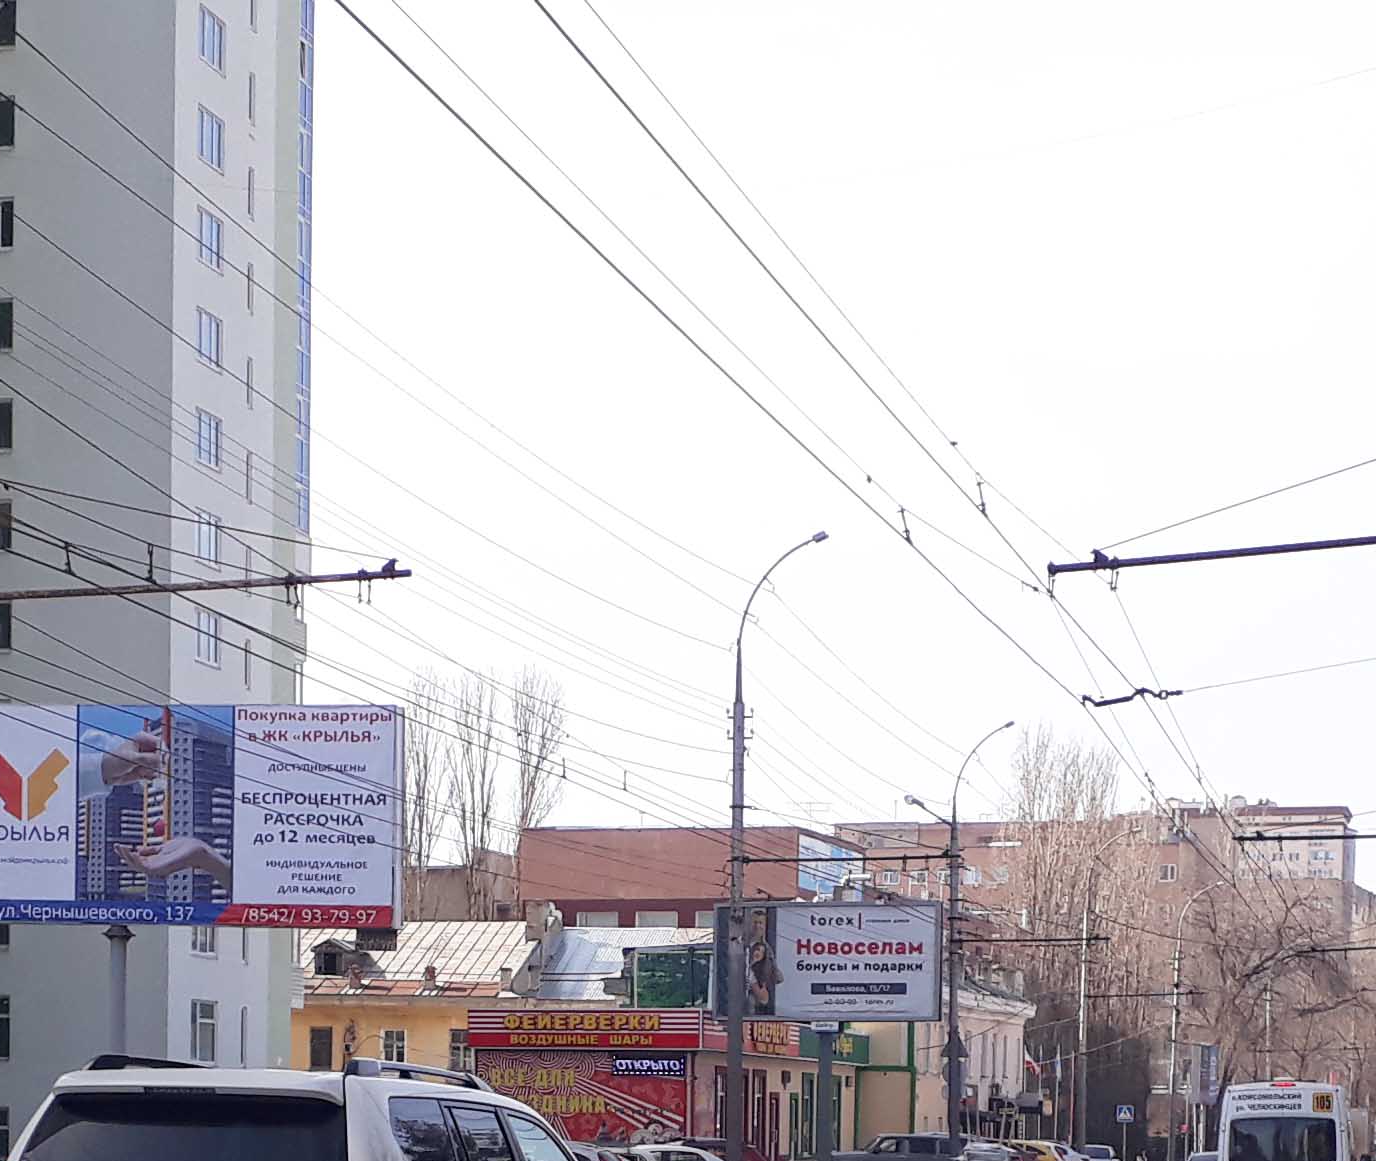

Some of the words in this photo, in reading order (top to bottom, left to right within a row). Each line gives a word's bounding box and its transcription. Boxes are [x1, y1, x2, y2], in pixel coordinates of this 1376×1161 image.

[237, 708, 307, 725] Покупка
[311, 711, 392, 726] квартиры
[248, 733, 257, 742] в
[262, 730, 288, 742] ЖК
[293, 730, 381, 743] «КРЫЛЬЯ»
[267, 763, 333, 773] ДОСТУПНЫЕ
[335, 764, 366, 774] ЦЕНЫ
[241, 792, 387, 809] БЕСПРОЦЕНТНАЯ
[264, 813, 364, 827] РАССРОЧКА
[253, 832, 274, 846] до
[279, 830, 298, 843] 12
[305, 833, 376, 846] месяцев
[265, 860, 368, 870] ИНДИВИДУАЛЬНОЕ
[291, 872, 342, 882] РЕШЕНИЕ
[277, 885, 299, 895] ДЛЯ
[301, 885, 356, 896] КАЖДОГО
[165, 906, 195, 921] 137
[241, 907, 296, 924] /8542/
[301, 909, 377, 924] 93-79-97
[810, 914, 855, 926] torex
[796, 938, 924, 956] Новоселам
[796, 960, 848, 974] бонусы
[851, 962, 860, 971] и
[864, 962, 923, 974] подарки
[504, 1014, 661, 1031] ФЕЙЕРВЕРКИ
[510, 1034, 599, 1046] ВОЗДУШНЫЕ
[609, 1034, 653, 1046] ШАРЫ
[616, 1058, 681, 1072] ОТКРЫТО
[1316, 1095, 1331, 1110] 105
